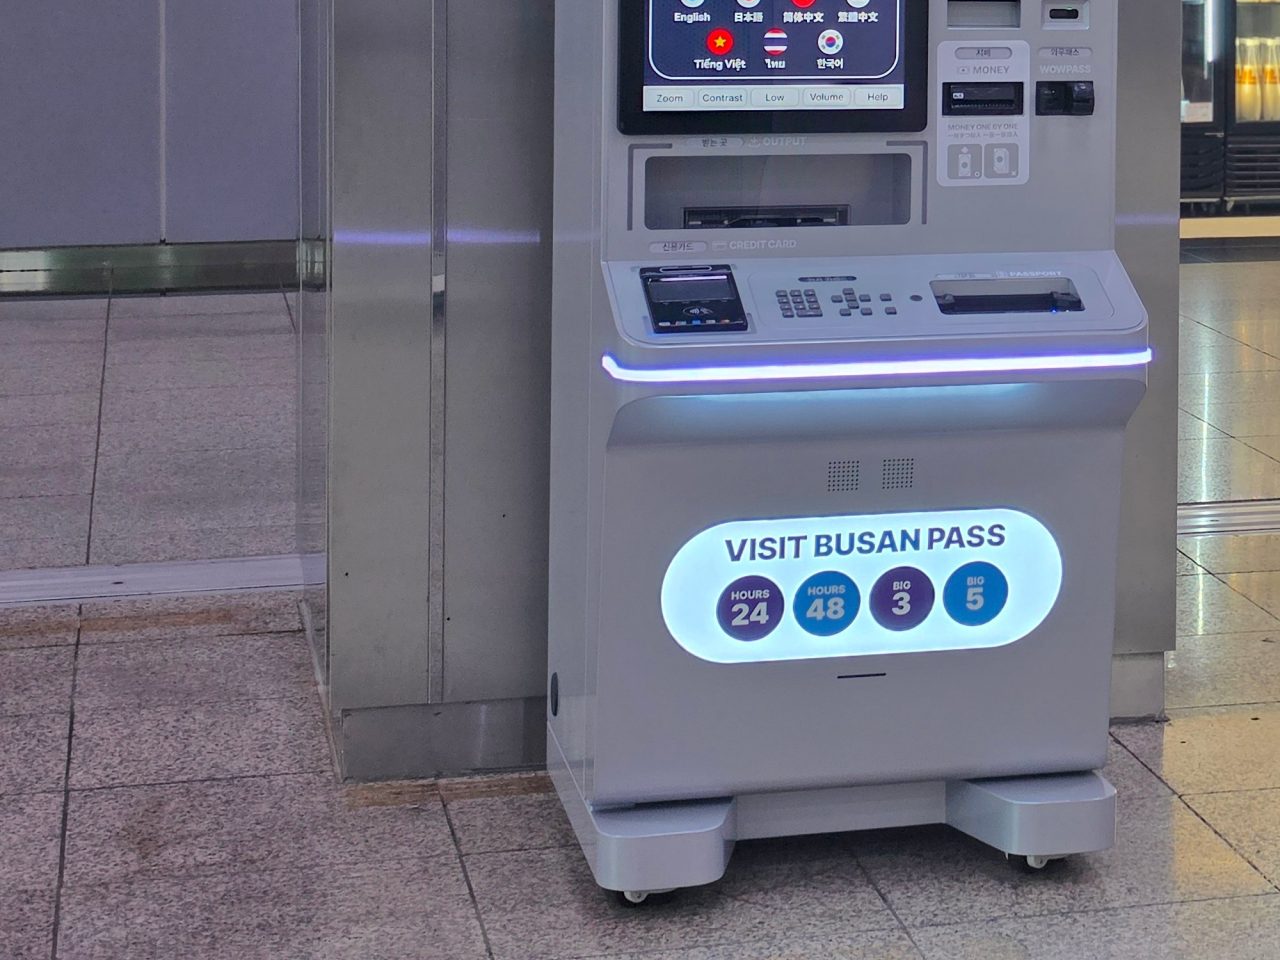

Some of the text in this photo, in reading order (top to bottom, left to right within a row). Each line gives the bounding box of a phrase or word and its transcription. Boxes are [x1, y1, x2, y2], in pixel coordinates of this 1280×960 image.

[674, 12, 711, 24] English
[734, 12, 764, 23] 日本語
[783, 11, 825, 23] 简体中文
[694, 58, 747, 72] Tiếng Việt
[764, 58, 786, 70] ไทย
[816, 58, 844, 70] 한국어
[972, 65, 1010, 75] MONEY
[1039, 64, 1092, 74] WOWPASS
[656, 91, 889, 103] Zoom Contrast Low Volume Help
[763, 136, 807, 146] OUTPUT
[662, 241, 694, 252] 신용카드
[729, 239, 797, 250] CREDIT CARD
[724, 523, 1007, 562] VISIT BUSAN PASS
[892, 580, 912, 591] BIG
[966, 575, 985, 586] BIG
[730, 589, 771, 601] HOURS
[806, 583, 847, 597] HOURS
[892, 591, 912, 616] 3
[965, 586, 985, 611] 5
[730, 601, 769, 627] 24
[806, 597, 846, 621] 48
